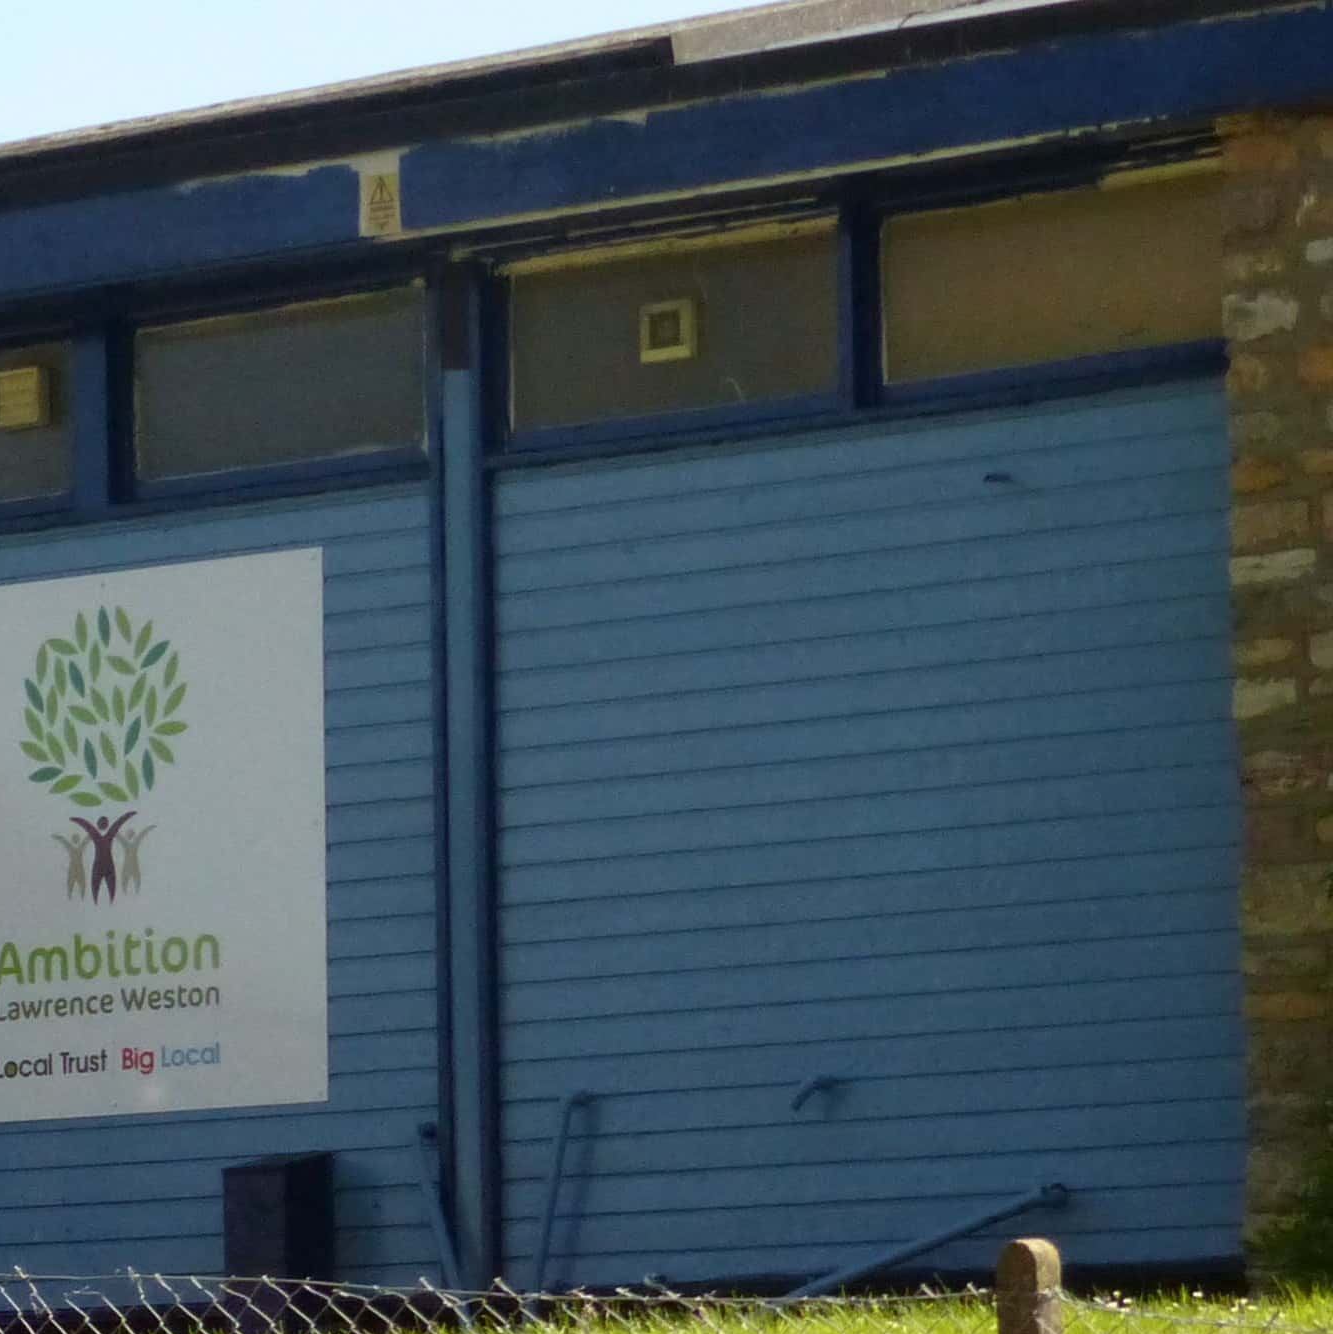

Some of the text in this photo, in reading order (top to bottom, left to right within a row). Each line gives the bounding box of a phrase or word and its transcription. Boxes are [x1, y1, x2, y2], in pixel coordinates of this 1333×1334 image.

[120, 986, 220, 1012] Weston
[59, 1049, 108, 1075] Trust
[121, 1047, 155, 1075] Big
[161, 1043, 221, 1068] Local
